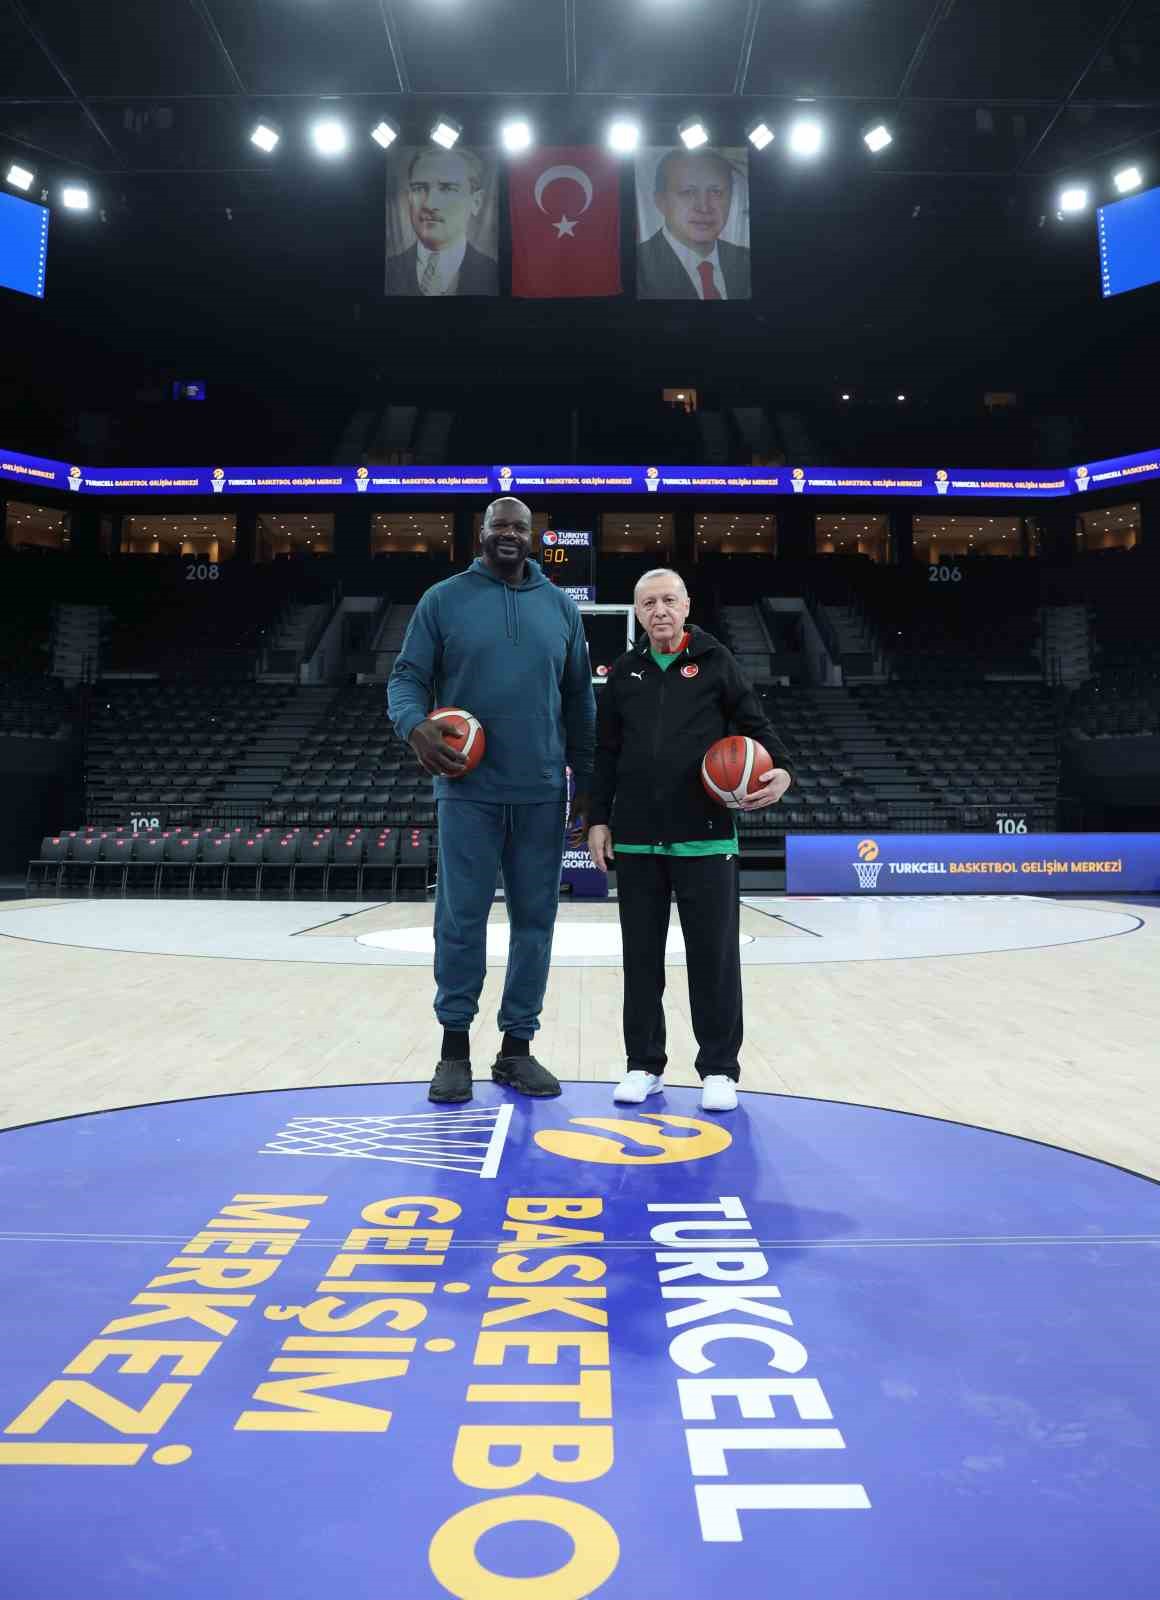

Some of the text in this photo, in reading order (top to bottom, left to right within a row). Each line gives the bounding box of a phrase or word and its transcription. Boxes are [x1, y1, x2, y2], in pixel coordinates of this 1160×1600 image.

[185, 564, 220, 580] 208
[928, 565, 962, 582] 206
[888, 859, 1122, 876] TURKCELL BASKETBOL GELİŞİM MERKEZİ
[996, 819, 1028, 834] 106
[0, 1194, 328, 1465] MERKEZİ
[234, 1197, 471, 1432] GELİŞİM
[647, 1196, 872, 1542] TURKCELL
[428, 1197, 620, 1600] BASKETBO
